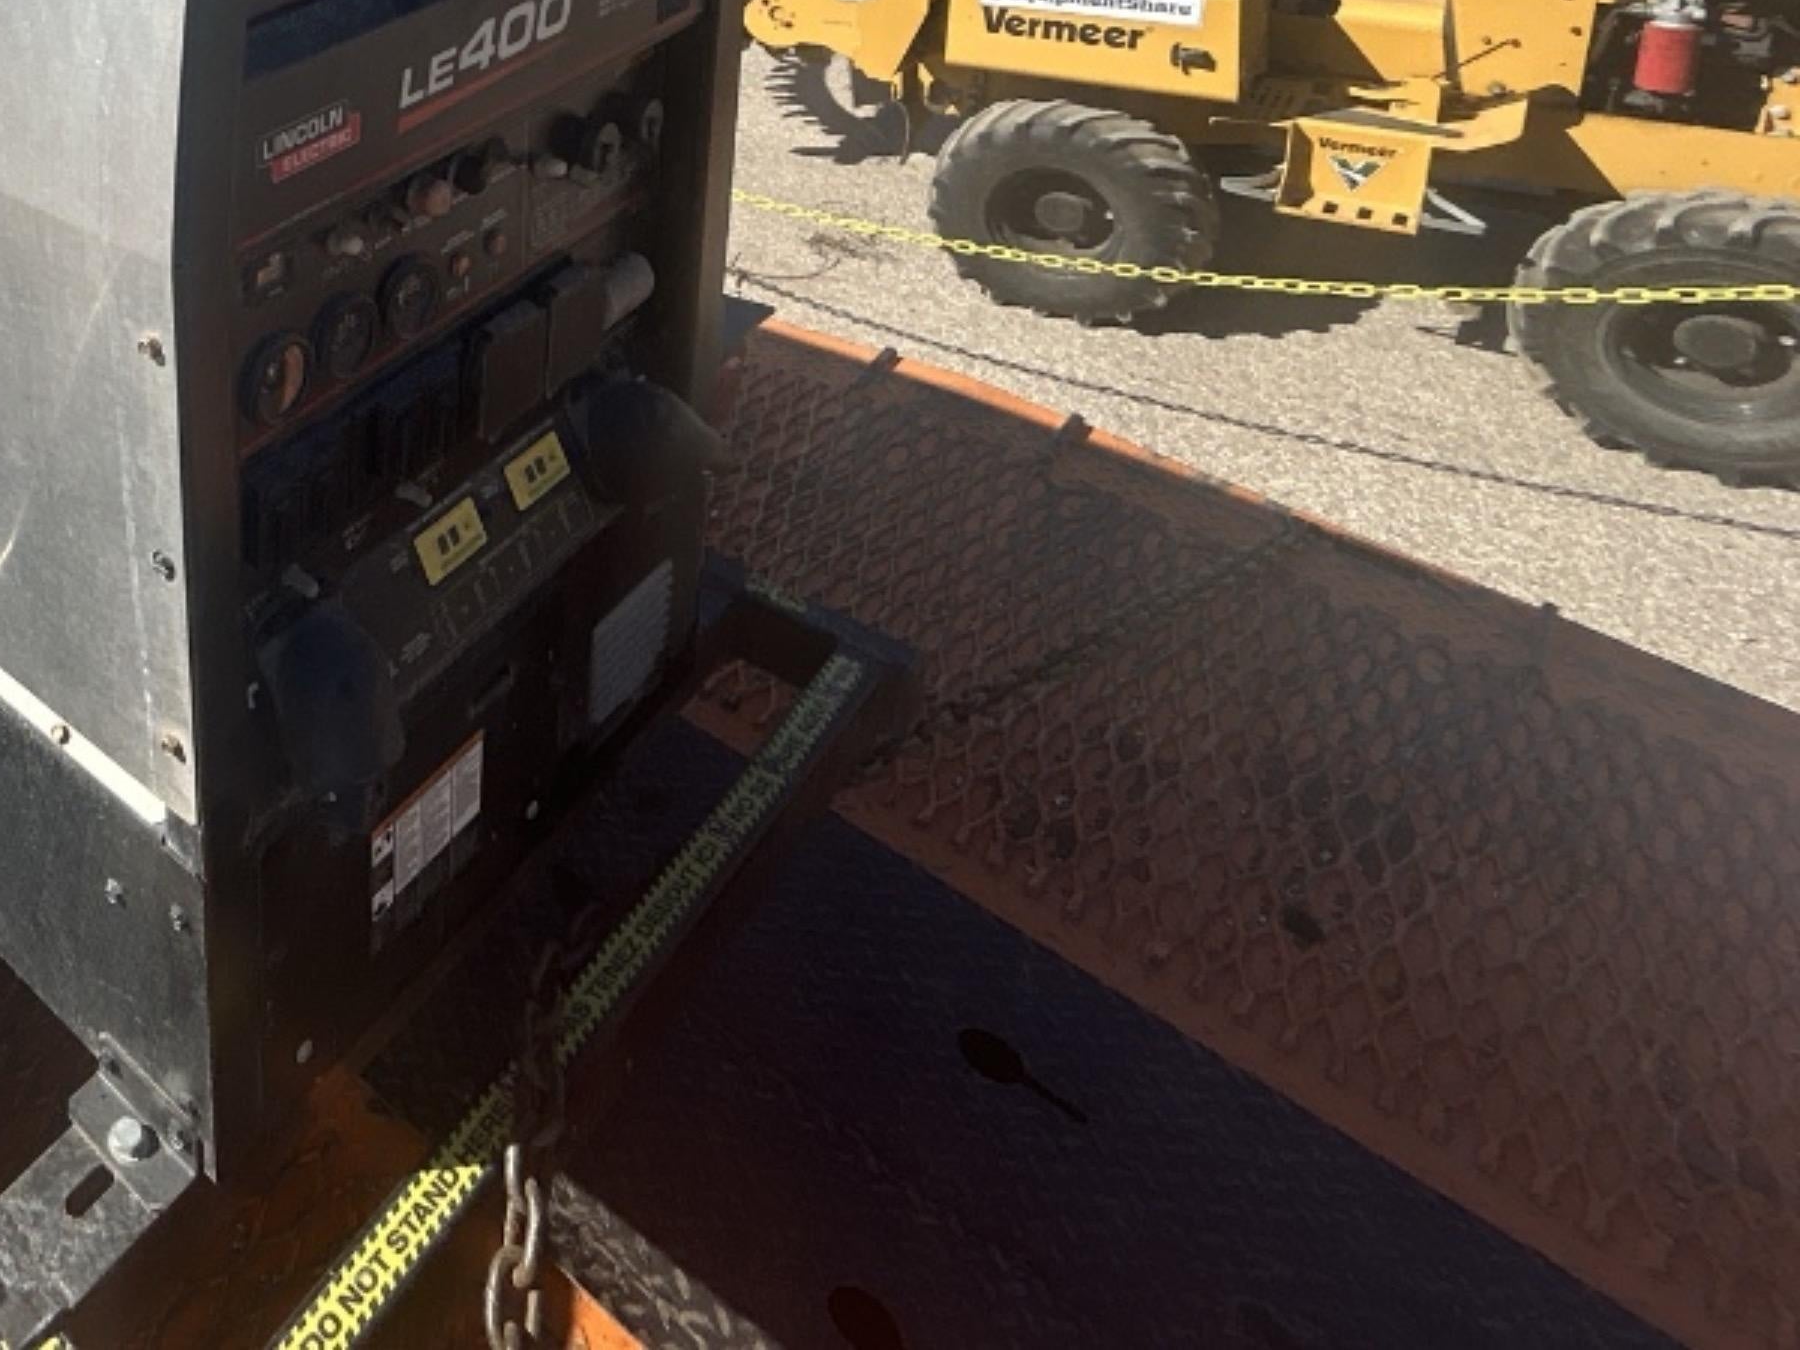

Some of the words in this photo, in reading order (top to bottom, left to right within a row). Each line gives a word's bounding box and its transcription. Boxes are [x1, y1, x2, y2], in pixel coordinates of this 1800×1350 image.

[983, 6, 1145, 50] Vermeer
[262, 106, 344, 161] LINCOLN
[337, 1248, 391, 1316] NOT
[386, 1167, 460, 1255] STAND
